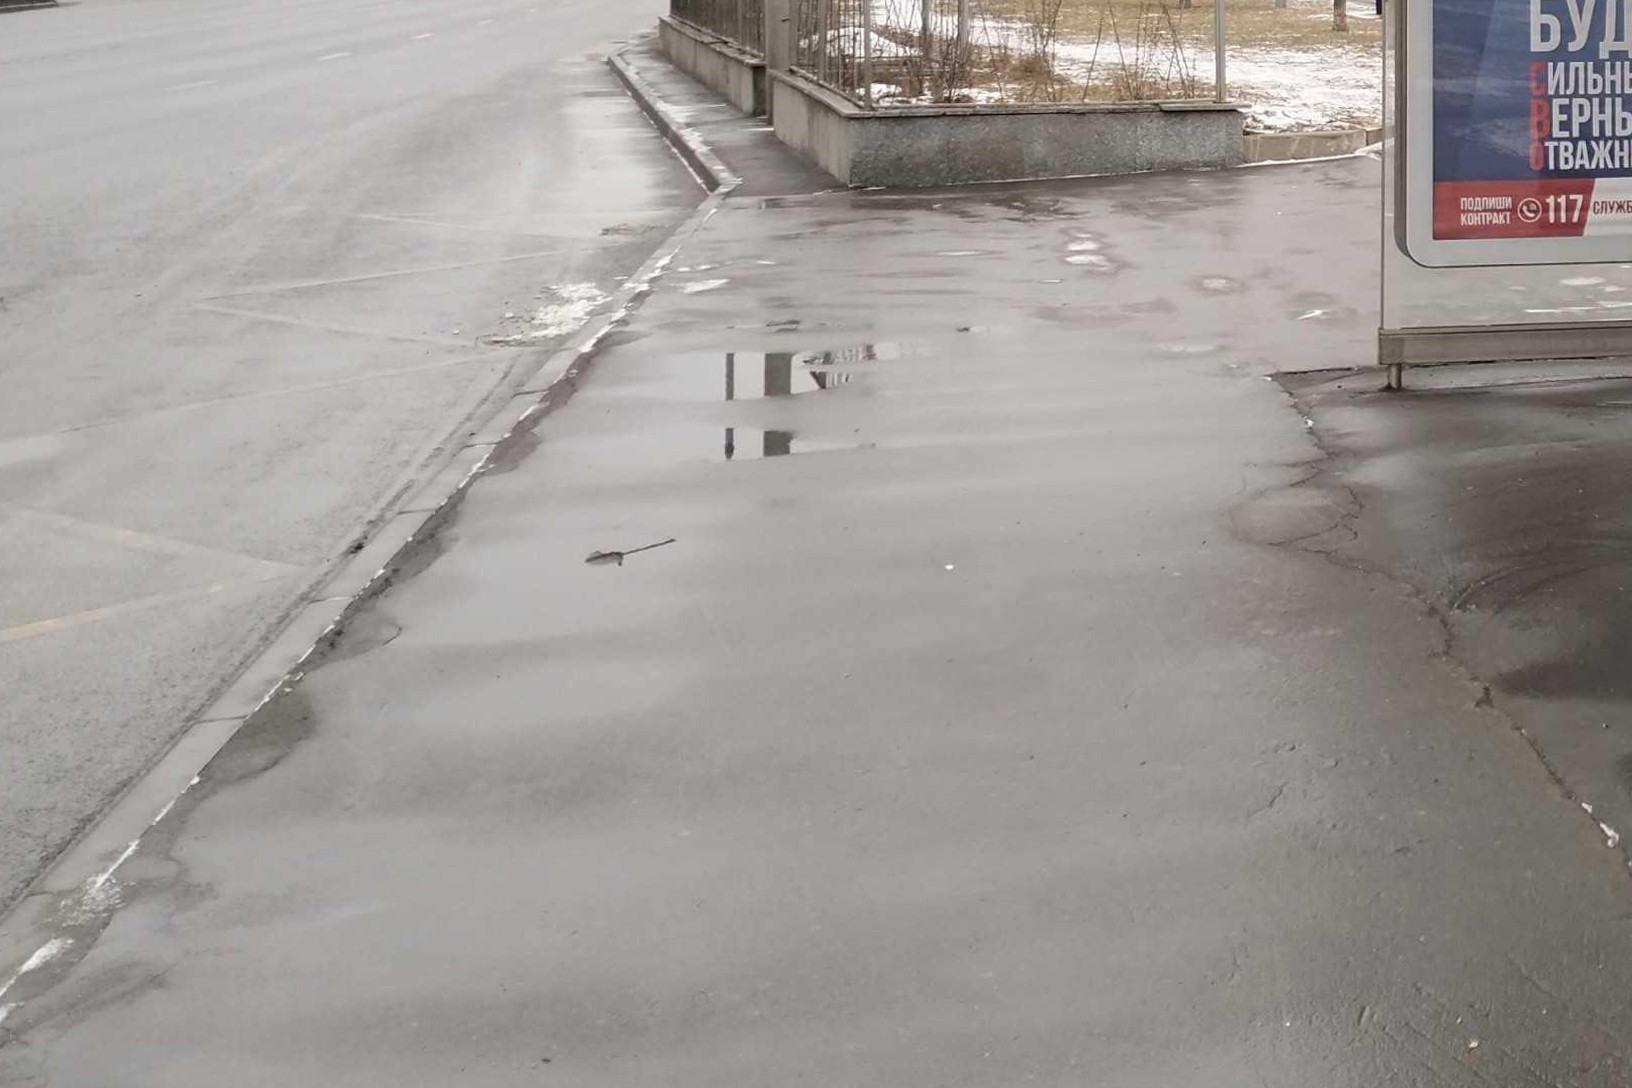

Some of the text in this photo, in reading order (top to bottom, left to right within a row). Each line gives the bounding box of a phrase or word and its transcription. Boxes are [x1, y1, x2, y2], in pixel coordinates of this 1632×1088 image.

[1460, 196, 1513, 212] ПОДПИШИ
[1545, 194, 1584, 224] 117
[1460, 212, 1511, 227] КОНТРАКТ
